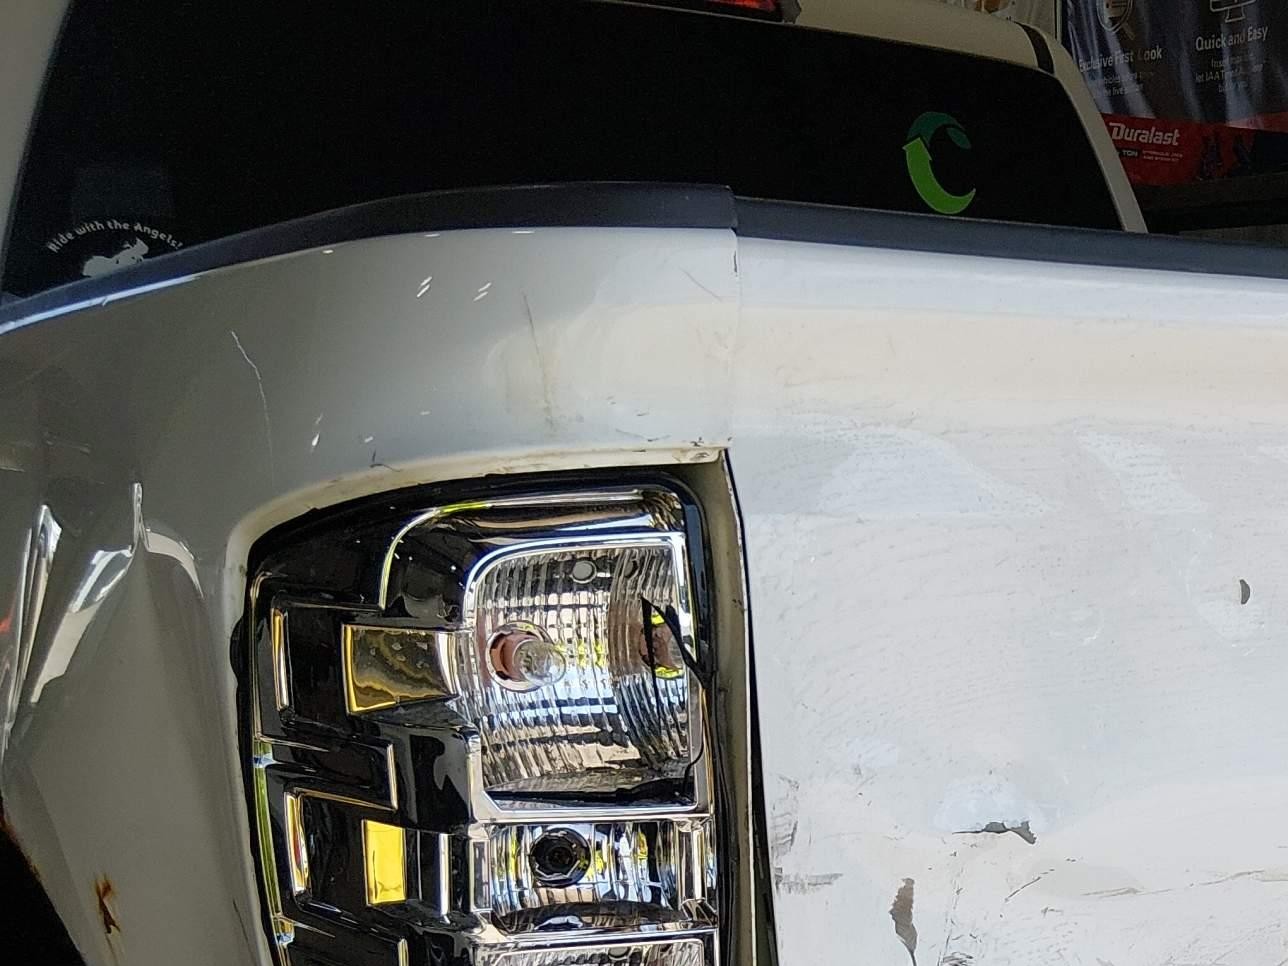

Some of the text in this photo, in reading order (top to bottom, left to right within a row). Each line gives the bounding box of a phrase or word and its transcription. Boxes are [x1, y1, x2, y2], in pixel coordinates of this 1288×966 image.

[1195, 33, 1227, 52] Quick
[1248, 25, 1269, 42] Easy
[1108, 122, 1181, 146] Duralast
[46, 232, 75, 254] Ride
[74, 220, 105, 236] with
[106, 218, 130, 231] the
